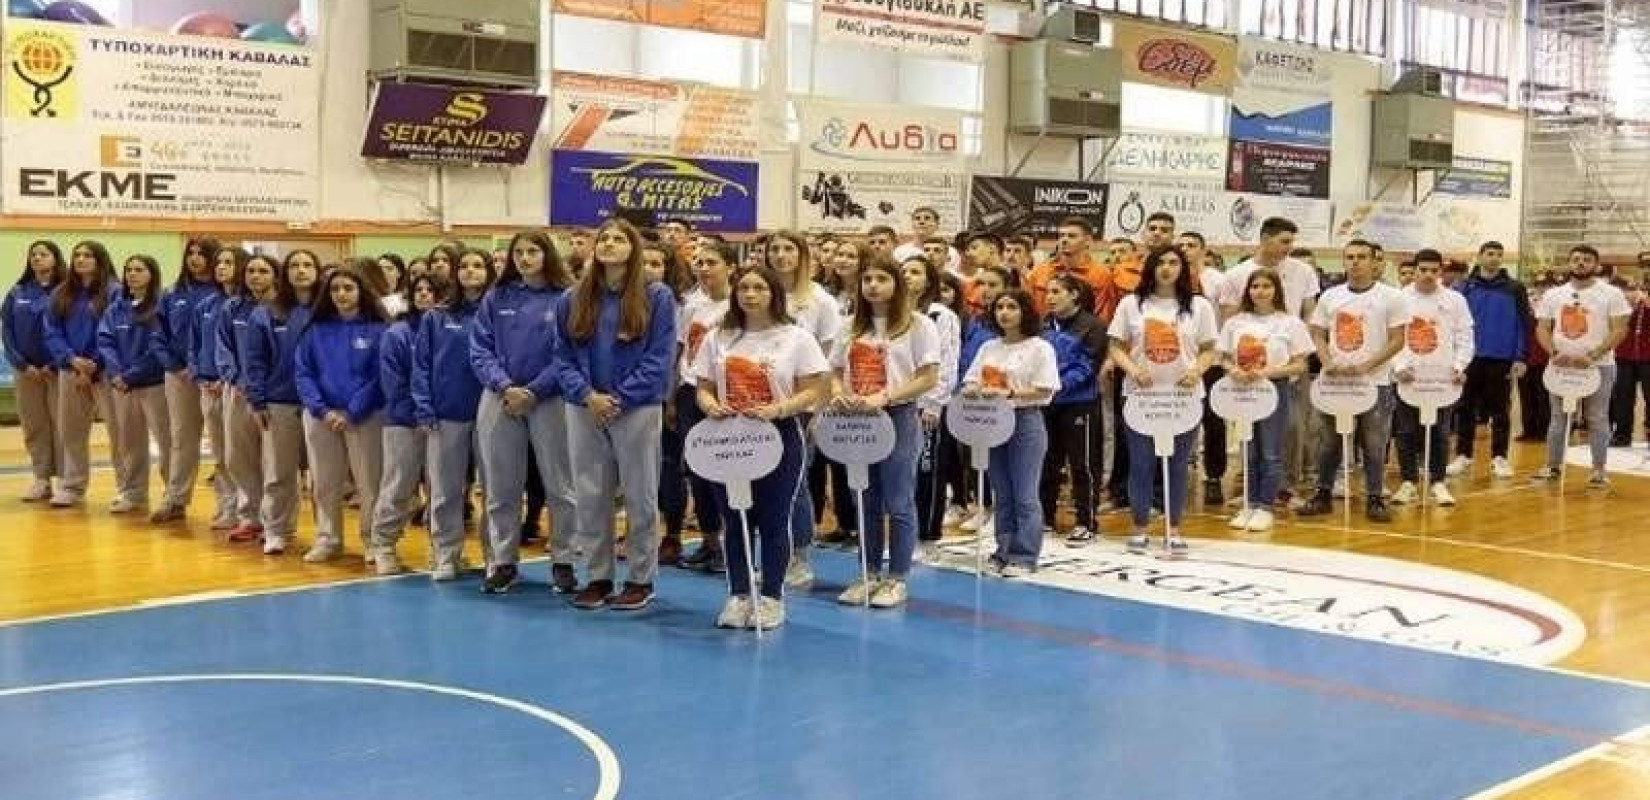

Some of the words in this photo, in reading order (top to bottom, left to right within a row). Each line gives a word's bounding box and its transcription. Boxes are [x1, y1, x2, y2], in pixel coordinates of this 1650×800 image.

[89, 38, 224, 61] ΤΥΠΟΧΑΡΤΙΚΗ
[229, 49, 311, 67] ΚΑΒΑΛΑΣ
[379, 123, 525, 150] SEITANIDIS
